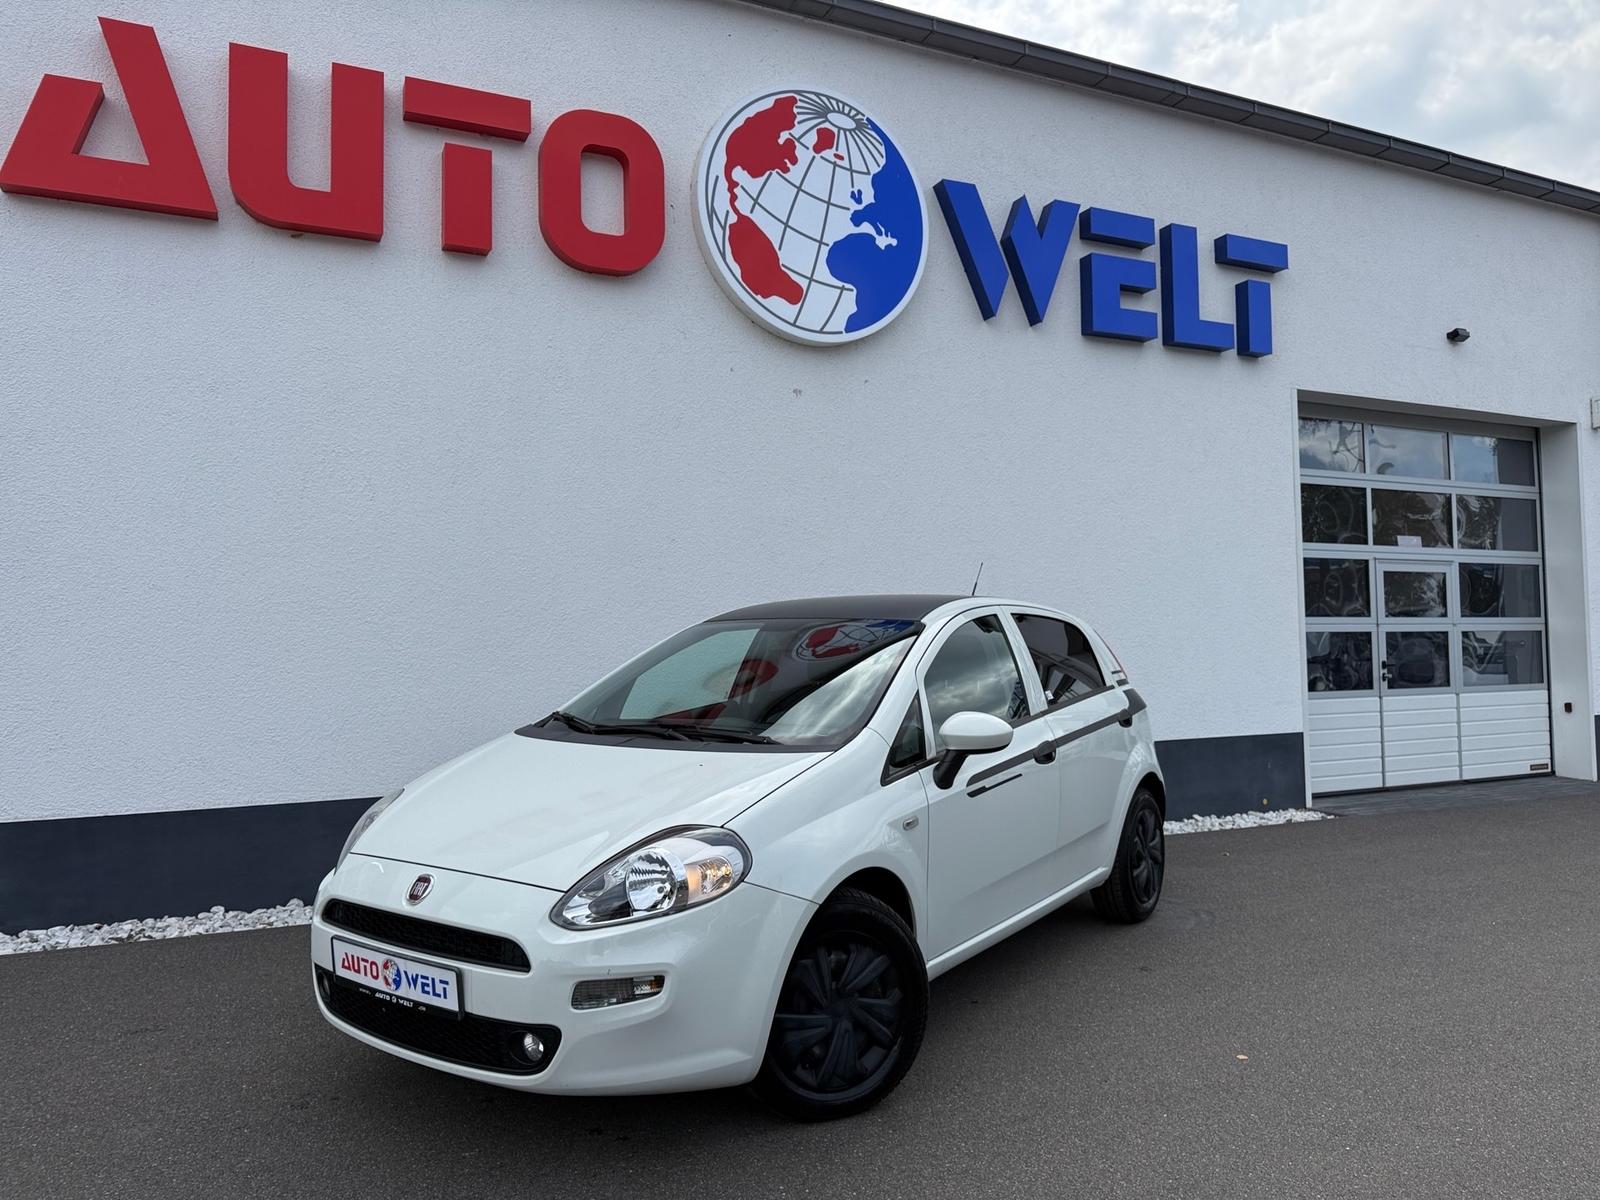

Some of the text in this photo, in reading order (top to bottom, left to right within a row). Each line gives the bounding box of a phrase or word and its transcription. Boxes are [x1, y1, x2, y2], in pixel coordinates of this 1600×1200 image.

[0, 16, 1288, 358] AUTO WELT
[411, 881, 429, 896] FIAT
[341, 952, 450, 1000] AUTO WELT
[374, 992, 414, 1008] AUTO WELT
